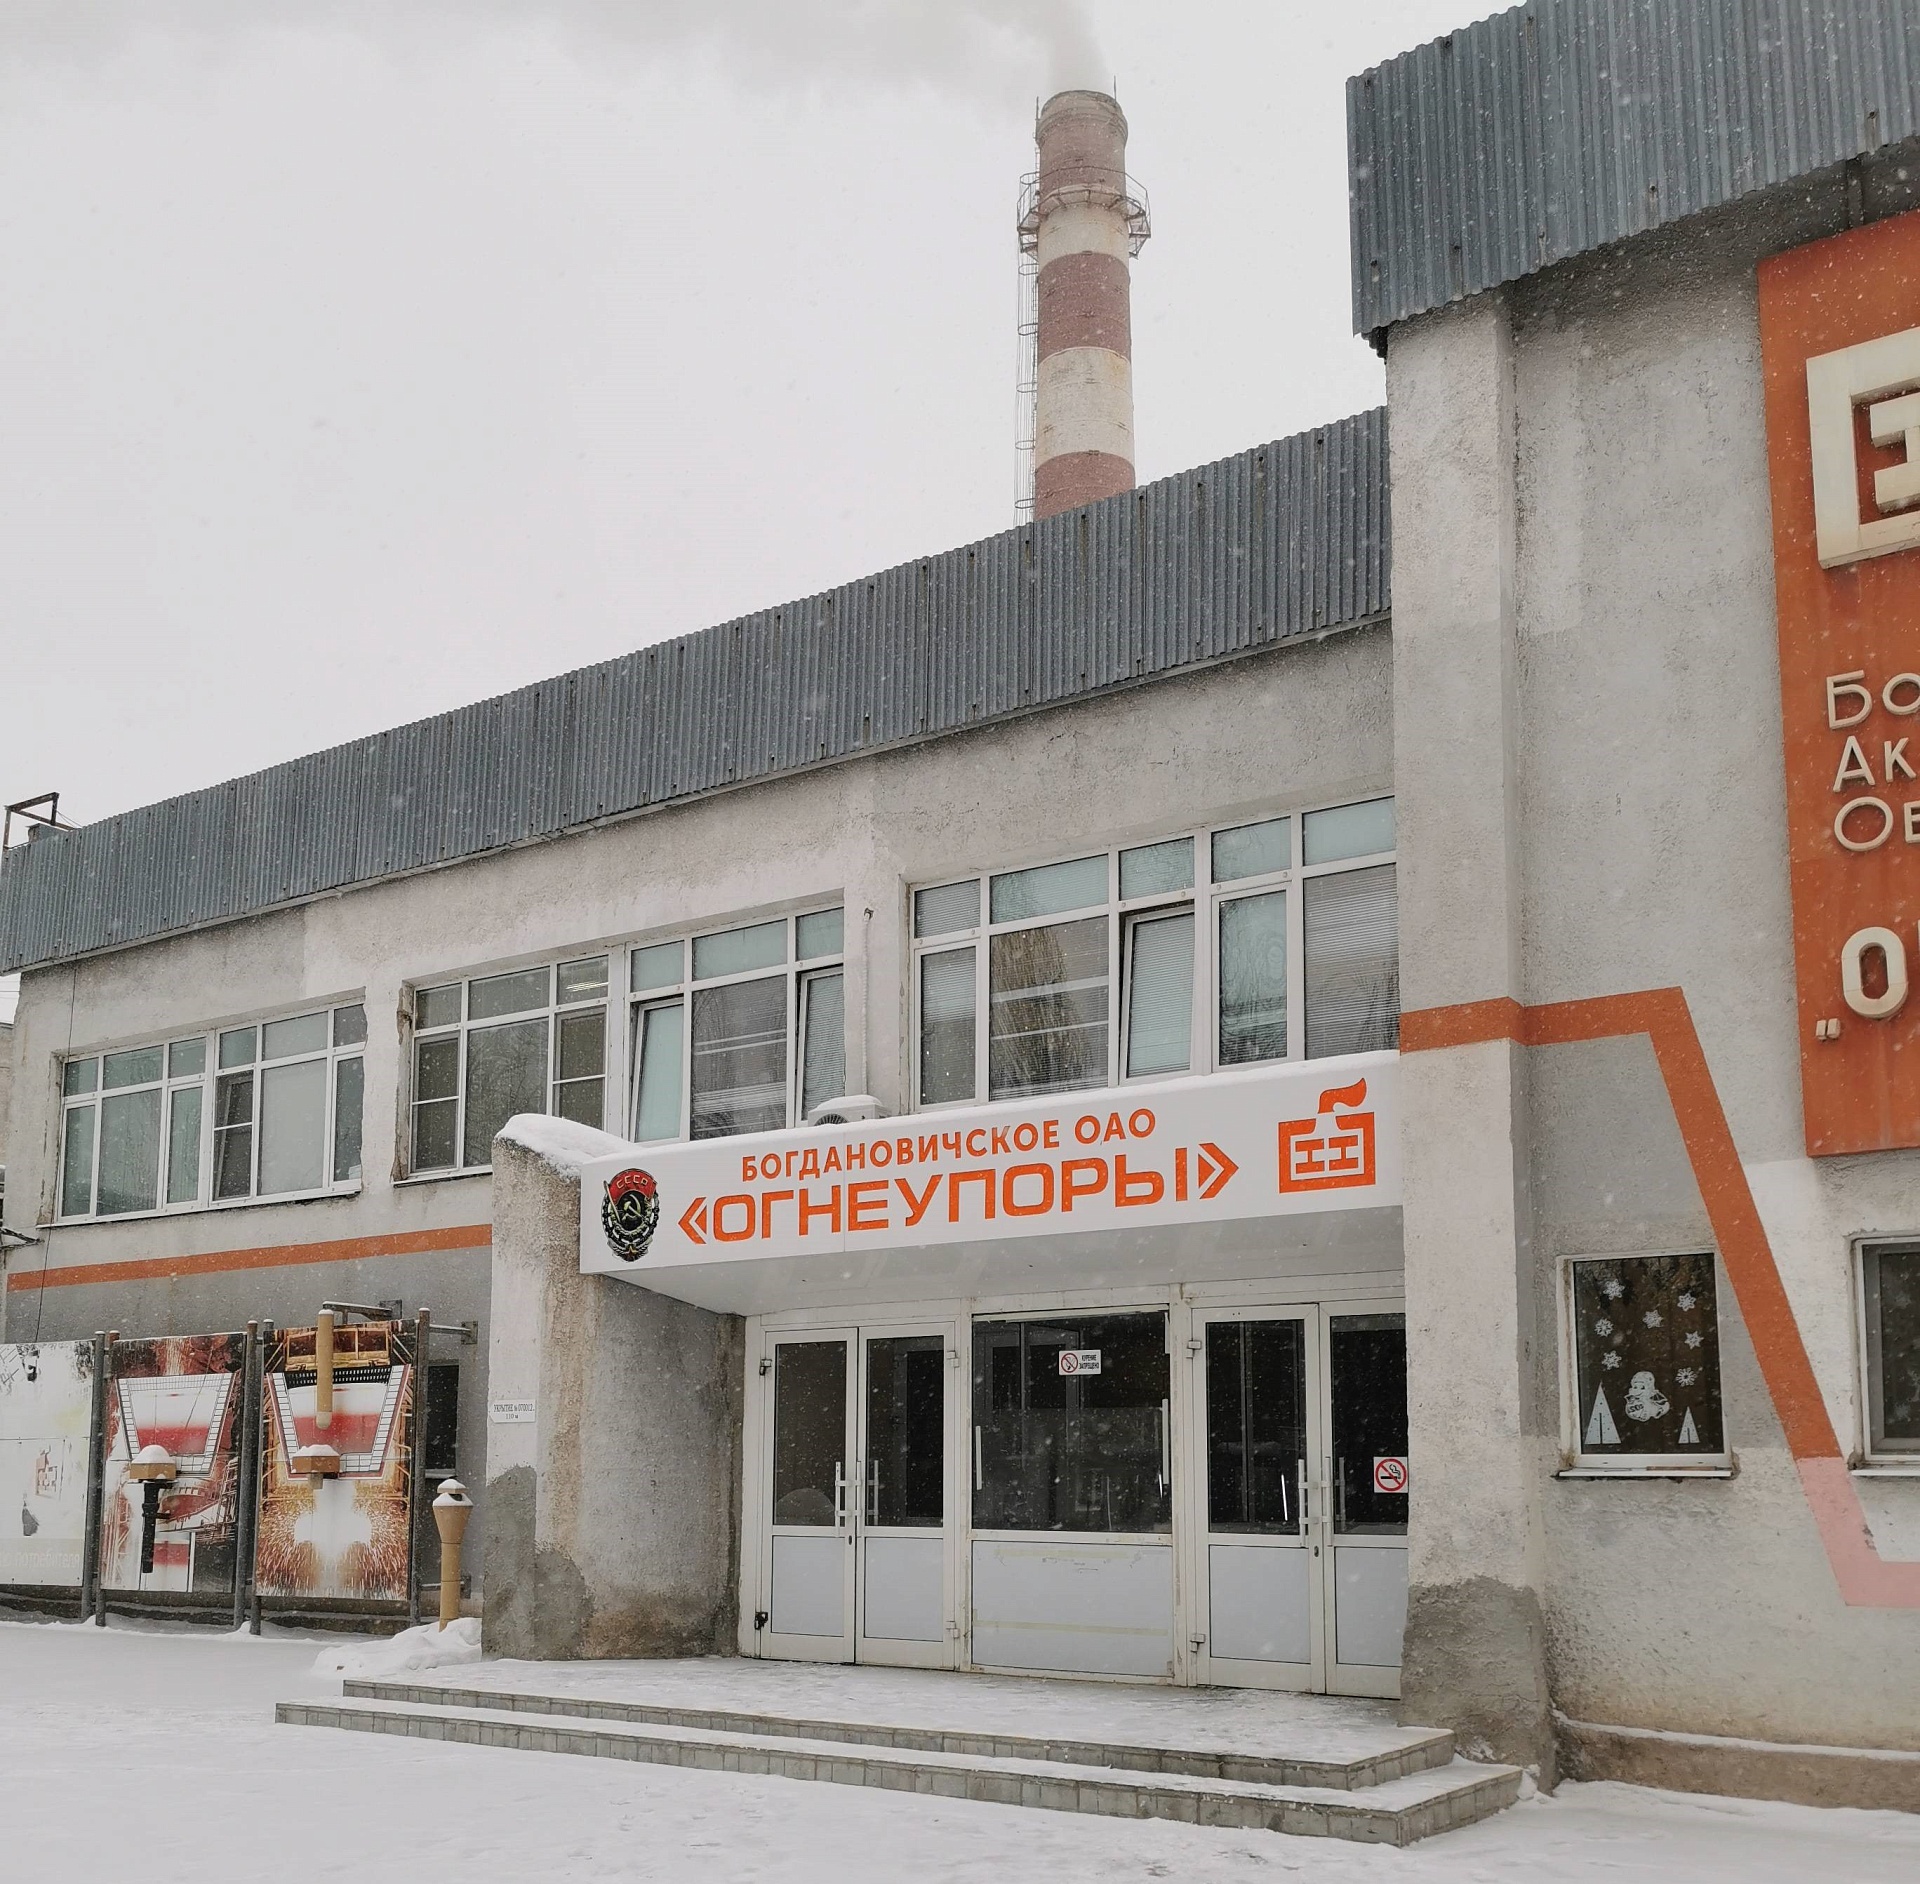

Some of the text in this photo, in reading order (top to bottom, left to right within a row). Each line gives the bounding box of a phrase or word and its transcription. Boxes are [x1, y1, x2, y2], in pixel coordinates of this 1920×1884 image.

[742, 1107, 1157, 1183] БОГДАНОВИЧСКОЕ ОАО
[678, 1142, 1239, 1246] «ОГНЕУПОРЫ»
